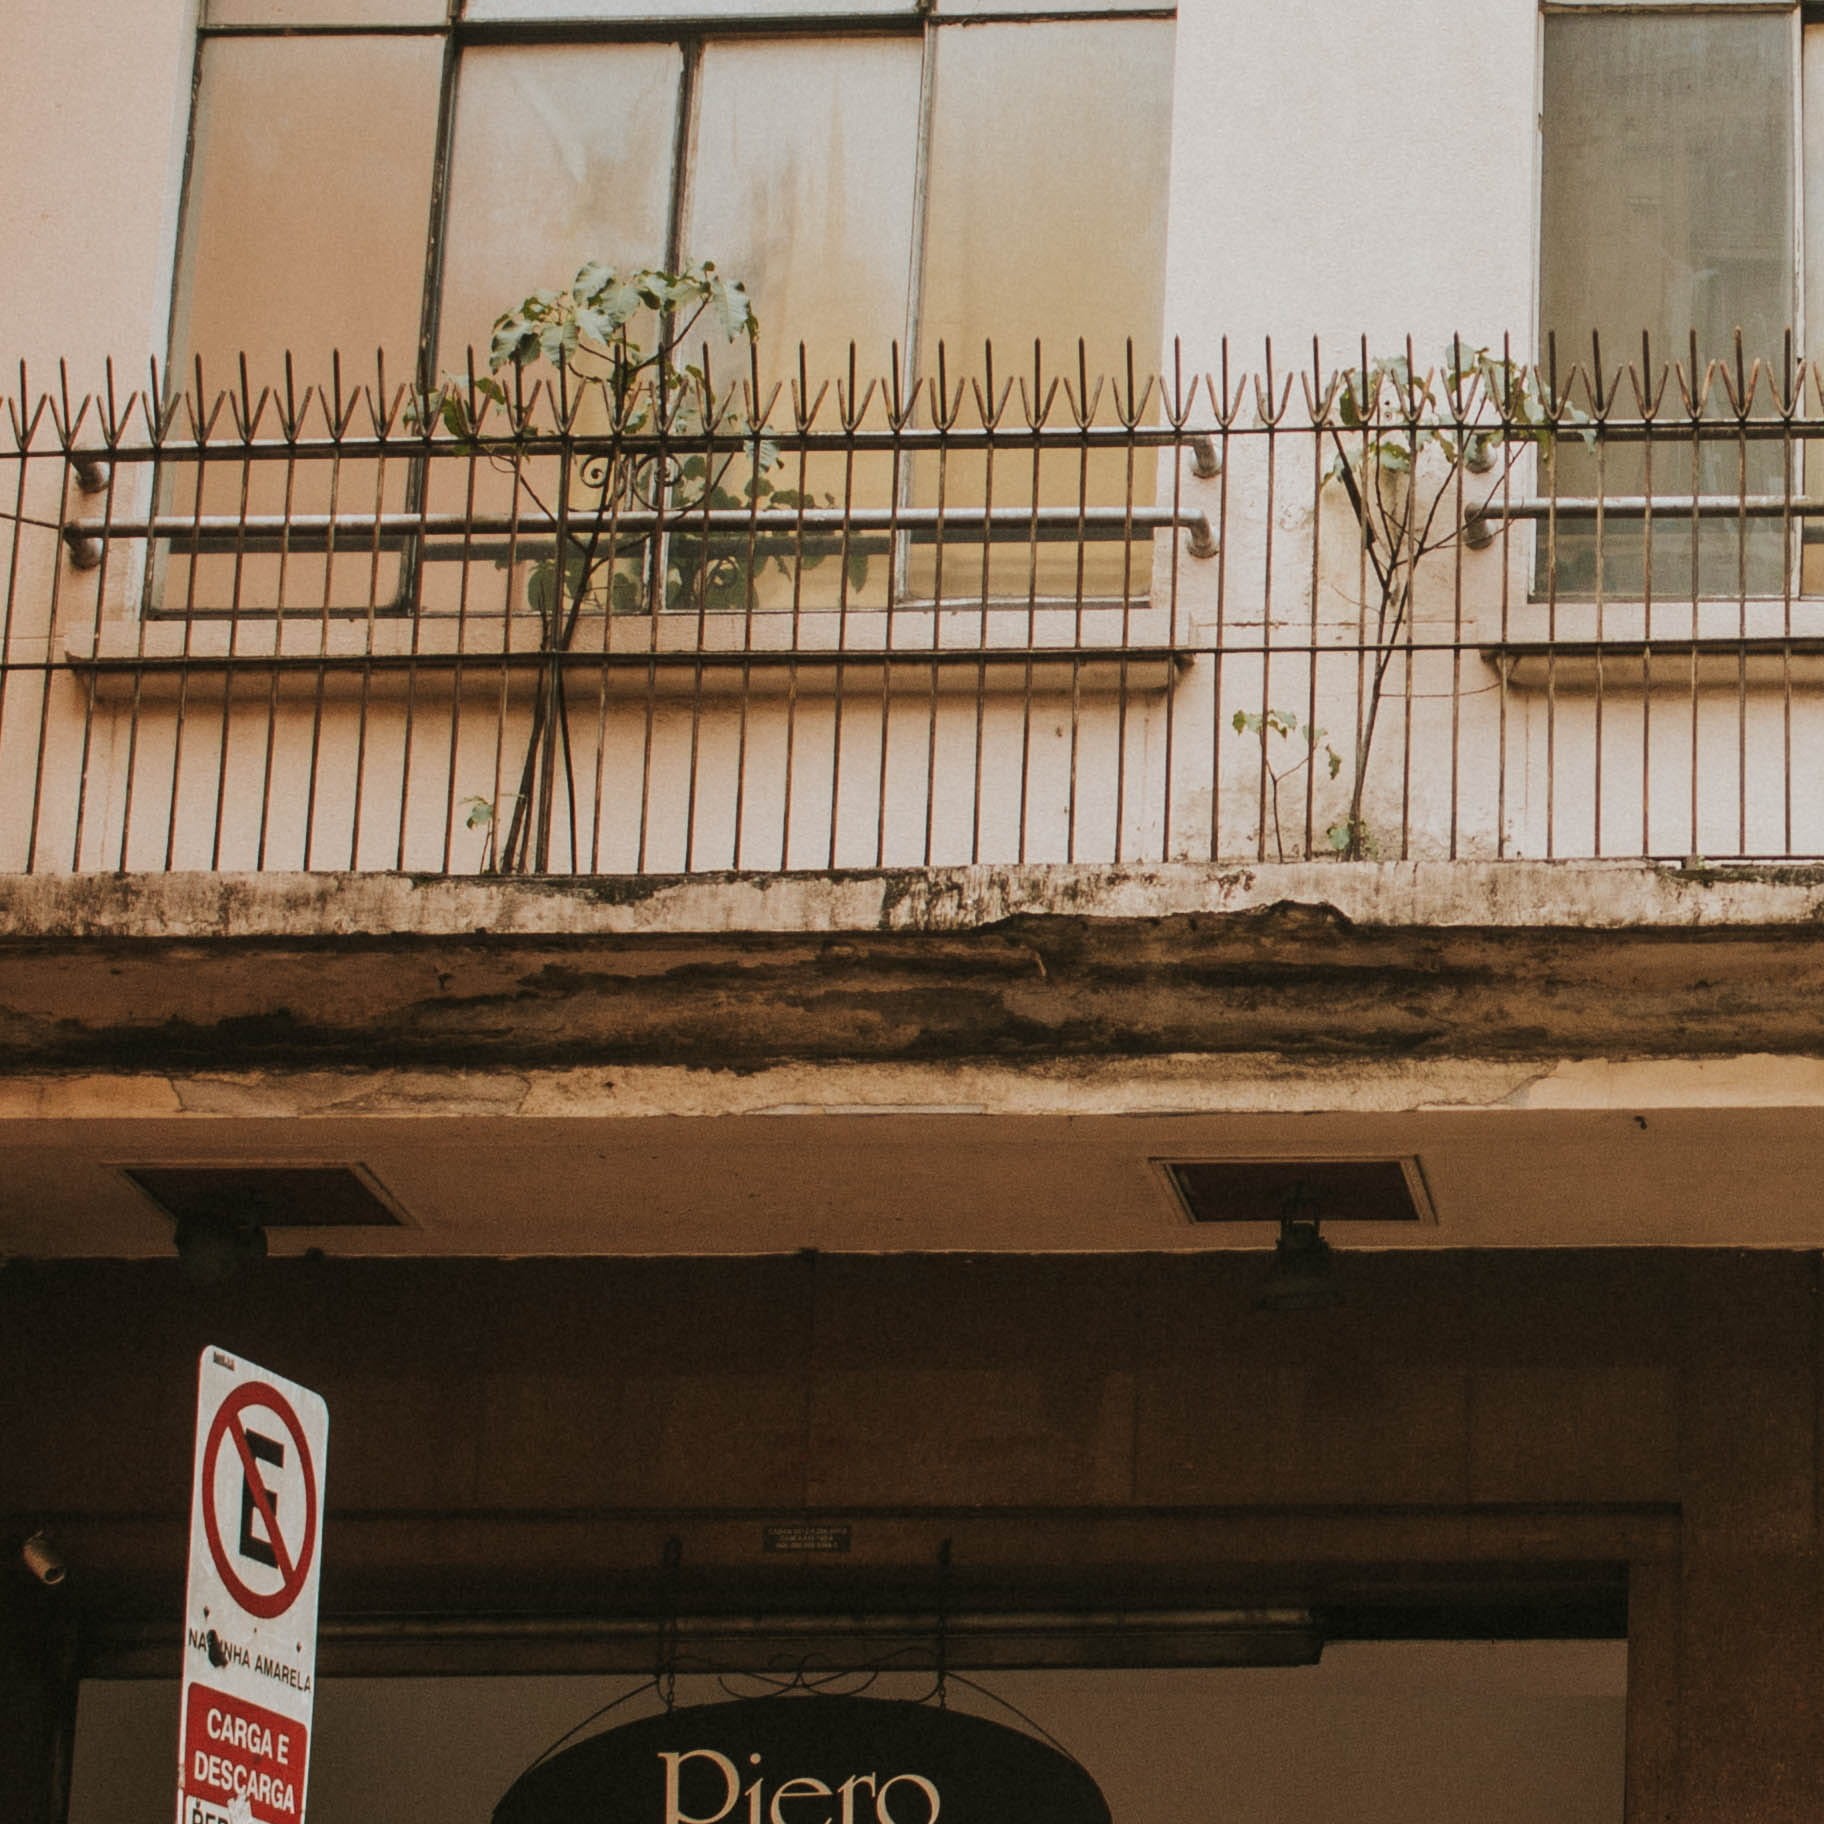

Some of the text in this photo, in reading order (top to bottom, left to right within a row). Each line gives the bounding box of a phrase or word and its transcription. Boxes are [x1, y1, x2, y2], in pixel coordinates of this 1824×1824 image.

[188, 1628, 207, 1652] NA
[255, 1655, 312, 1693] AMARELA
[207, 1708, 290, 1766] CARGA E
[193, 1750, 295, 1815] DESCARGA
